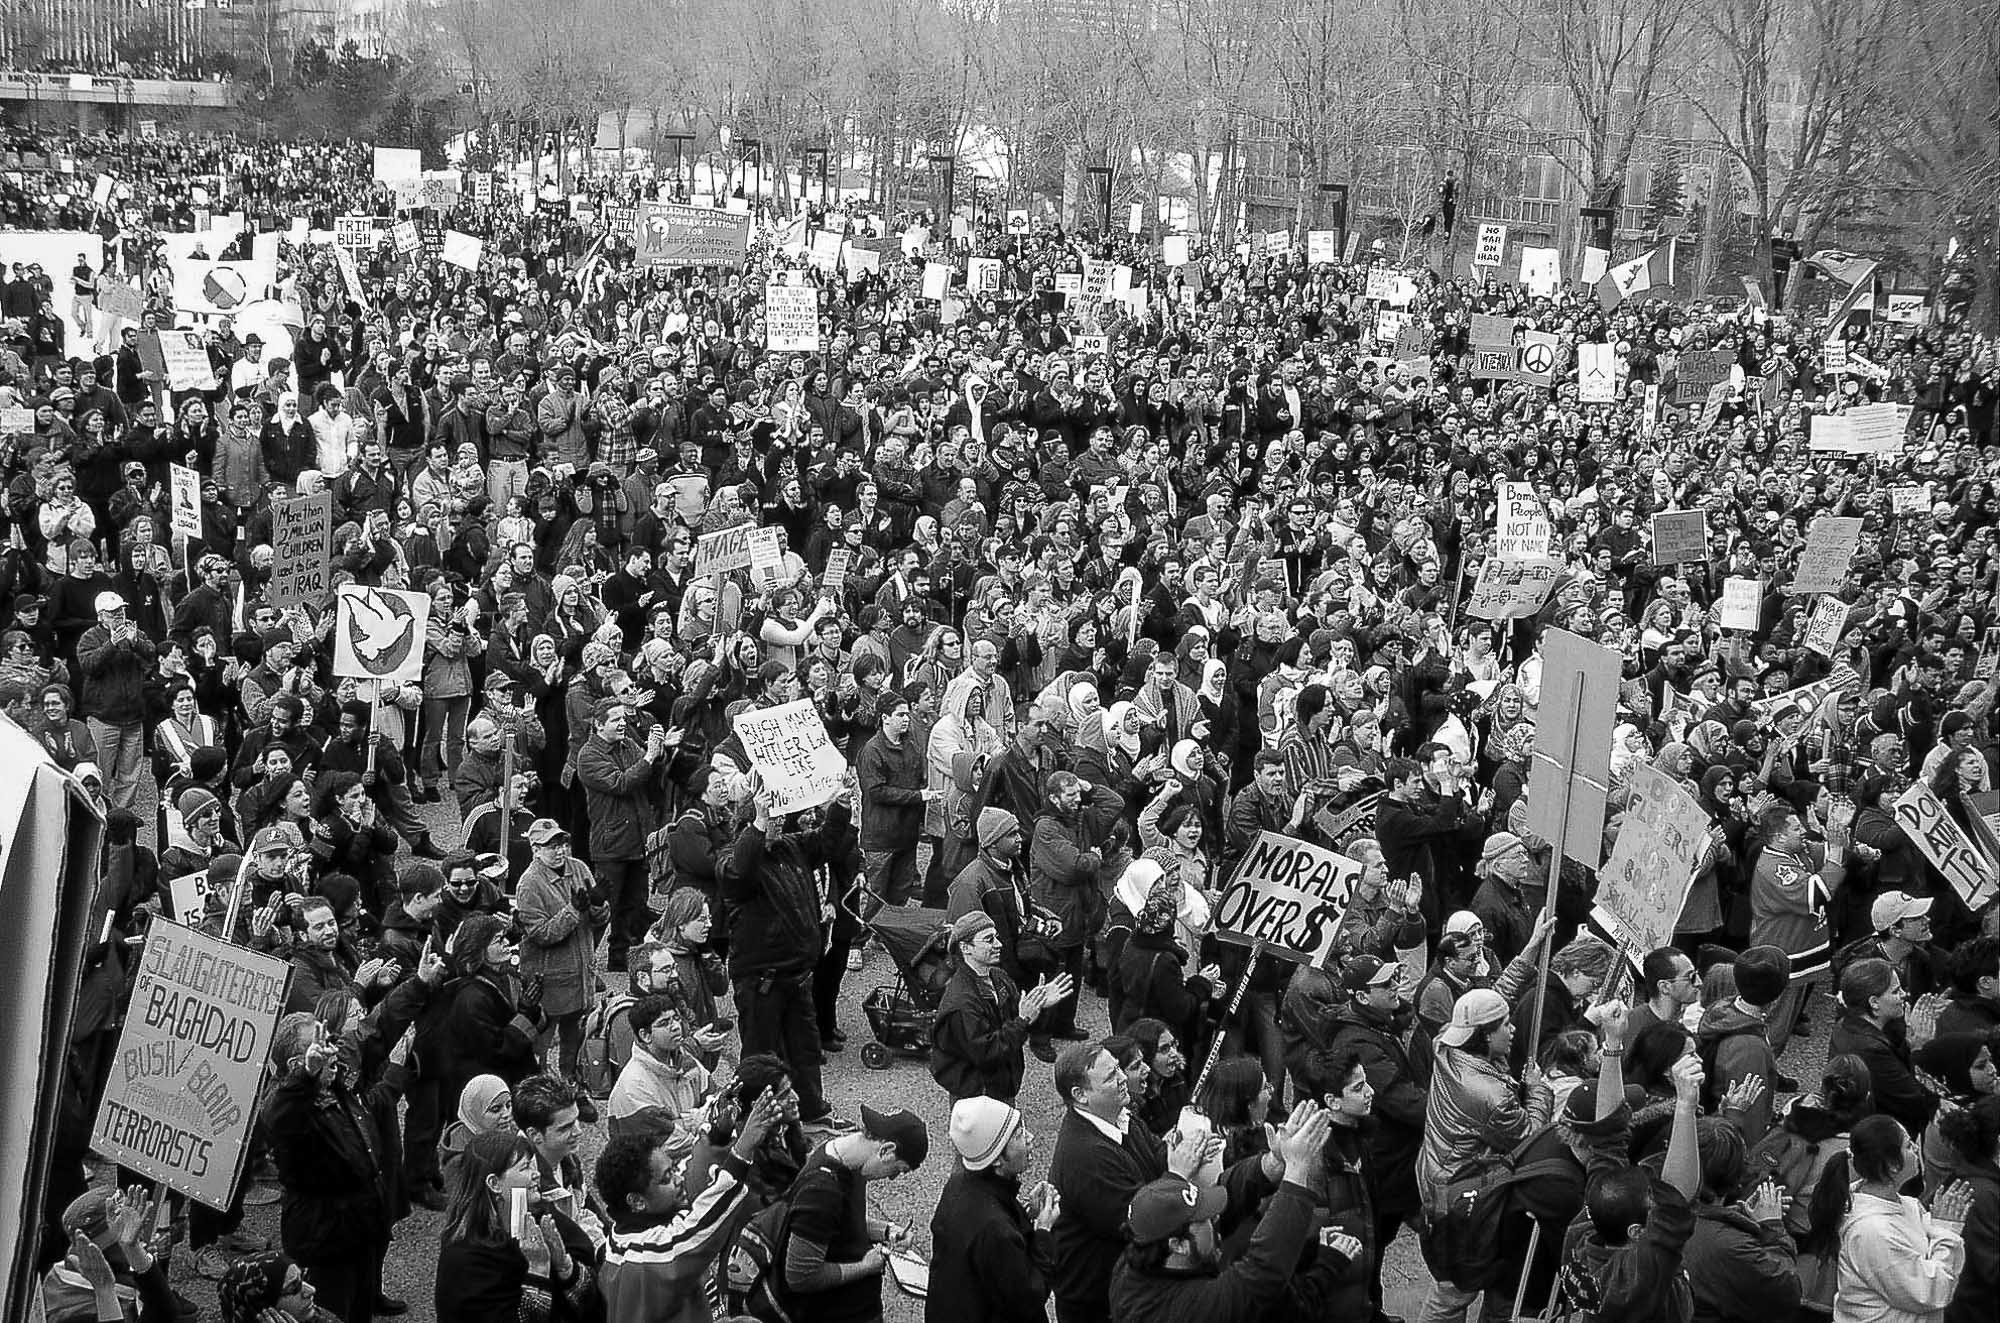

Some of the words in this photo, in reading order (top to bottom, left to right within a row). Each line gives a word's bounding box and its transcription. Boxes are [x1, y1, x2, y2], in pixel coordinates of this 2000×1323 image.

[648, 205, 697, 217] CANADIAN
[699, 210, 744, 222] CATHOLIC
[669, 217, 738, 230] ORGANIZATION
[338, 219, 371, 232] TRIM
[1485, 226, 1499, 234] NO
[337, 233, 371, 245] BUSH
[1482, 235, 1500, 243] WAR
[688, 246, 705, 255] AND
[711, 247, 740, 257] PEACE
[1478, 253, 1499, 263] IRAQ
[1092, 267, 1106, 276] NO
[1083, 339, 1101, 349] NO
[277, 503, 302, 527] More
[303, 503, 323, 519] than
[277, 528, 289, 546] 2
[288, 517, 324, 541] MILLION
[1507, 522, 1532, 537] NOT
[1535, 523, 1547, 537] IN
[281, 539, 324, 560] CHILDREN
[703, 527, 751, 564] WAGE
[1500, 538, 1517, 552] MY
[1521, 539, 1545, 553] NAME
[280, 580, 289, 596] in
[293, 572, 324, 597] IRAQ
[1822, 602, 1843, 619] WAR
[740, 718, 783, 745] BUSH
[754, 736, 809, 766] HITLER
[783, 754, 816, 777] LIKE
[1244, 841, 1361, 909] MORALS
[1214, 881, 1302, 944] OVER
[146, 935, 284, 1015] SLAUGHTERERS
[145, 984, 257, 1063] BAGHDAD
[187, 1059, 242, 1136] BLAIR
[103, 1100, 213, 1177] TERRORISTS
